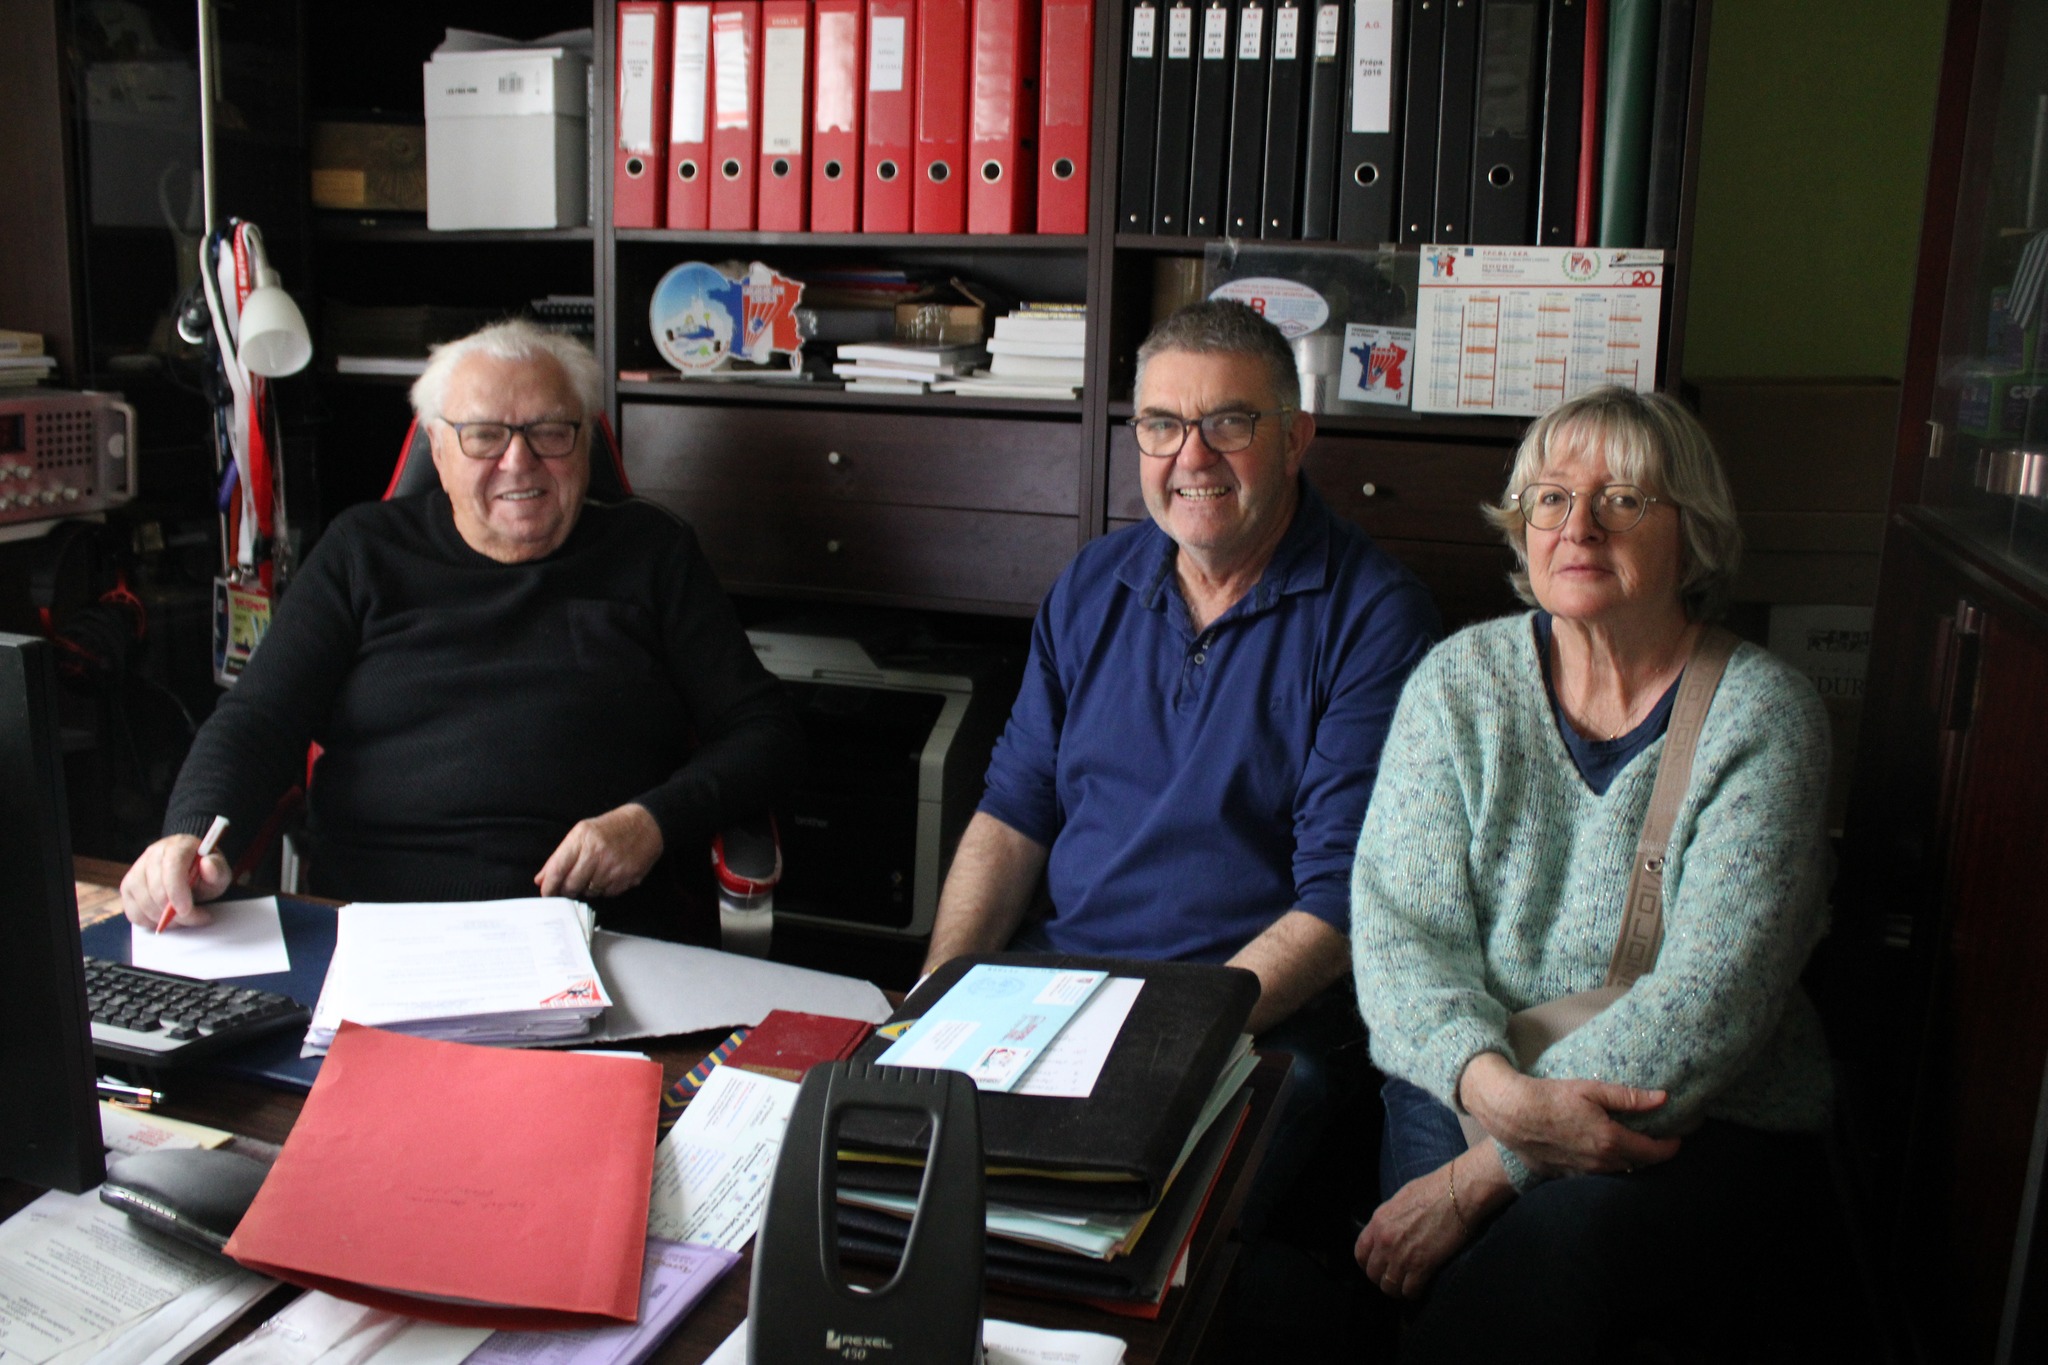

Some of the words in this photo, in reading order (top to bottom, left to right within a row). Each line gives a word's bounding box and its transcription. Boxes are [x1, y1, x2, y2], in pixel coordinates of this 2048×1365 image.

[1613, 270, 1656, 287] 2020
[842, 1334, 893, 1350] REXEL
[841, 1347, 866, 1361] 450
